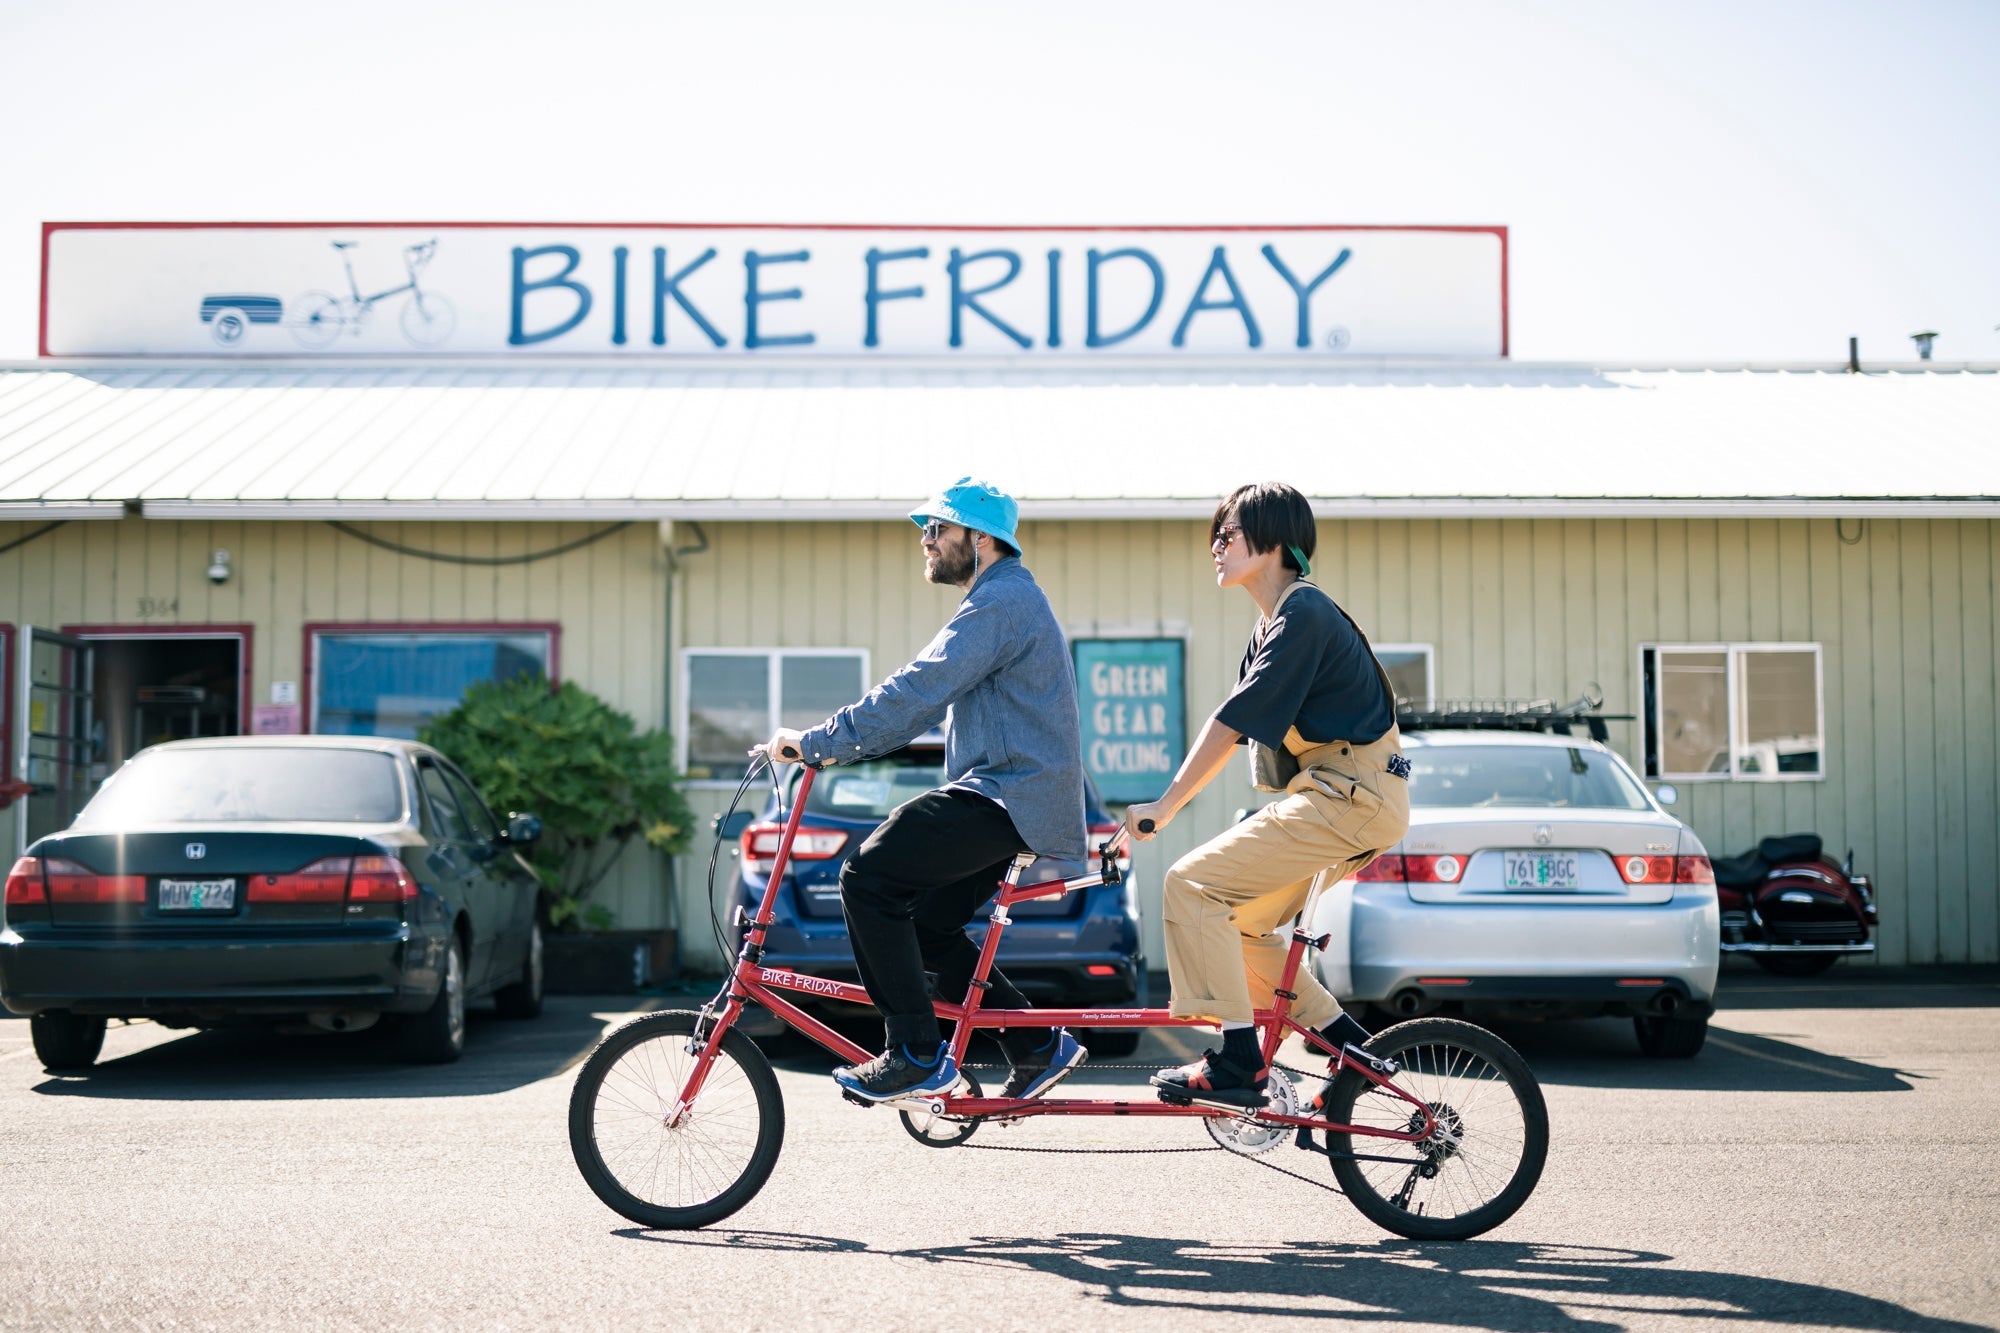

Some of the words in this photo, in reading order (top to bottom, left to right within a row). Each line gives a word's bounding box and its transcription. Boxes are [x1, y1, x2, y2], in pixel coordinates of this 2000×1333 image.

[508, 244, 816, 350] BIKE
[864, 243, 1352, 350] FRIDAY
[1090, 660, 1168, 697] GREEN
[1093, 700, 1166, 736] GEAR
[1089, 739, 1171, 774] CYCLING
[1508, 859, 1534, 879] 761
[1546, 859, 1575, 879] BGC
[761, 970, 792, 986] BIKE
[794, 977, 842, 995] FRIDAY
